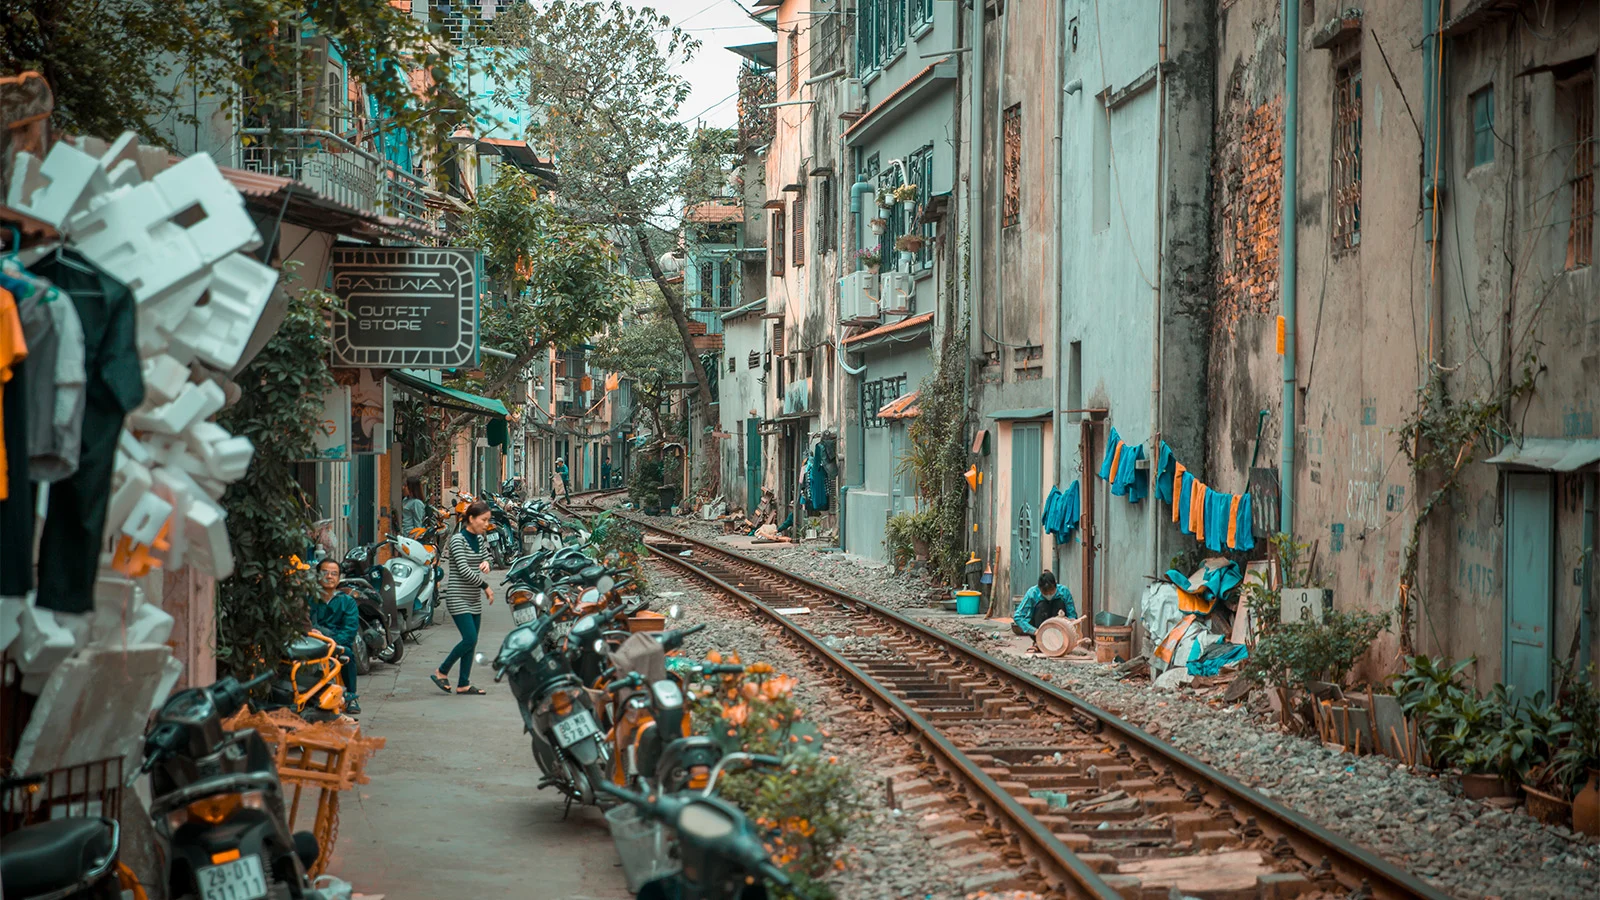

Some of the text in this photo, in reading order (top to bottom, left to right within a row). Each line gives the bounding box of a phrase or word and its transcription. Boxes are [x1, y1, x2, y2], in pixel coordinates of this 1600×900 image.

[335, 278, 457, 291] RAILWAY
[359, 306, 431, 317] OUTFIT
[359, 320, 422, 331] STORE
